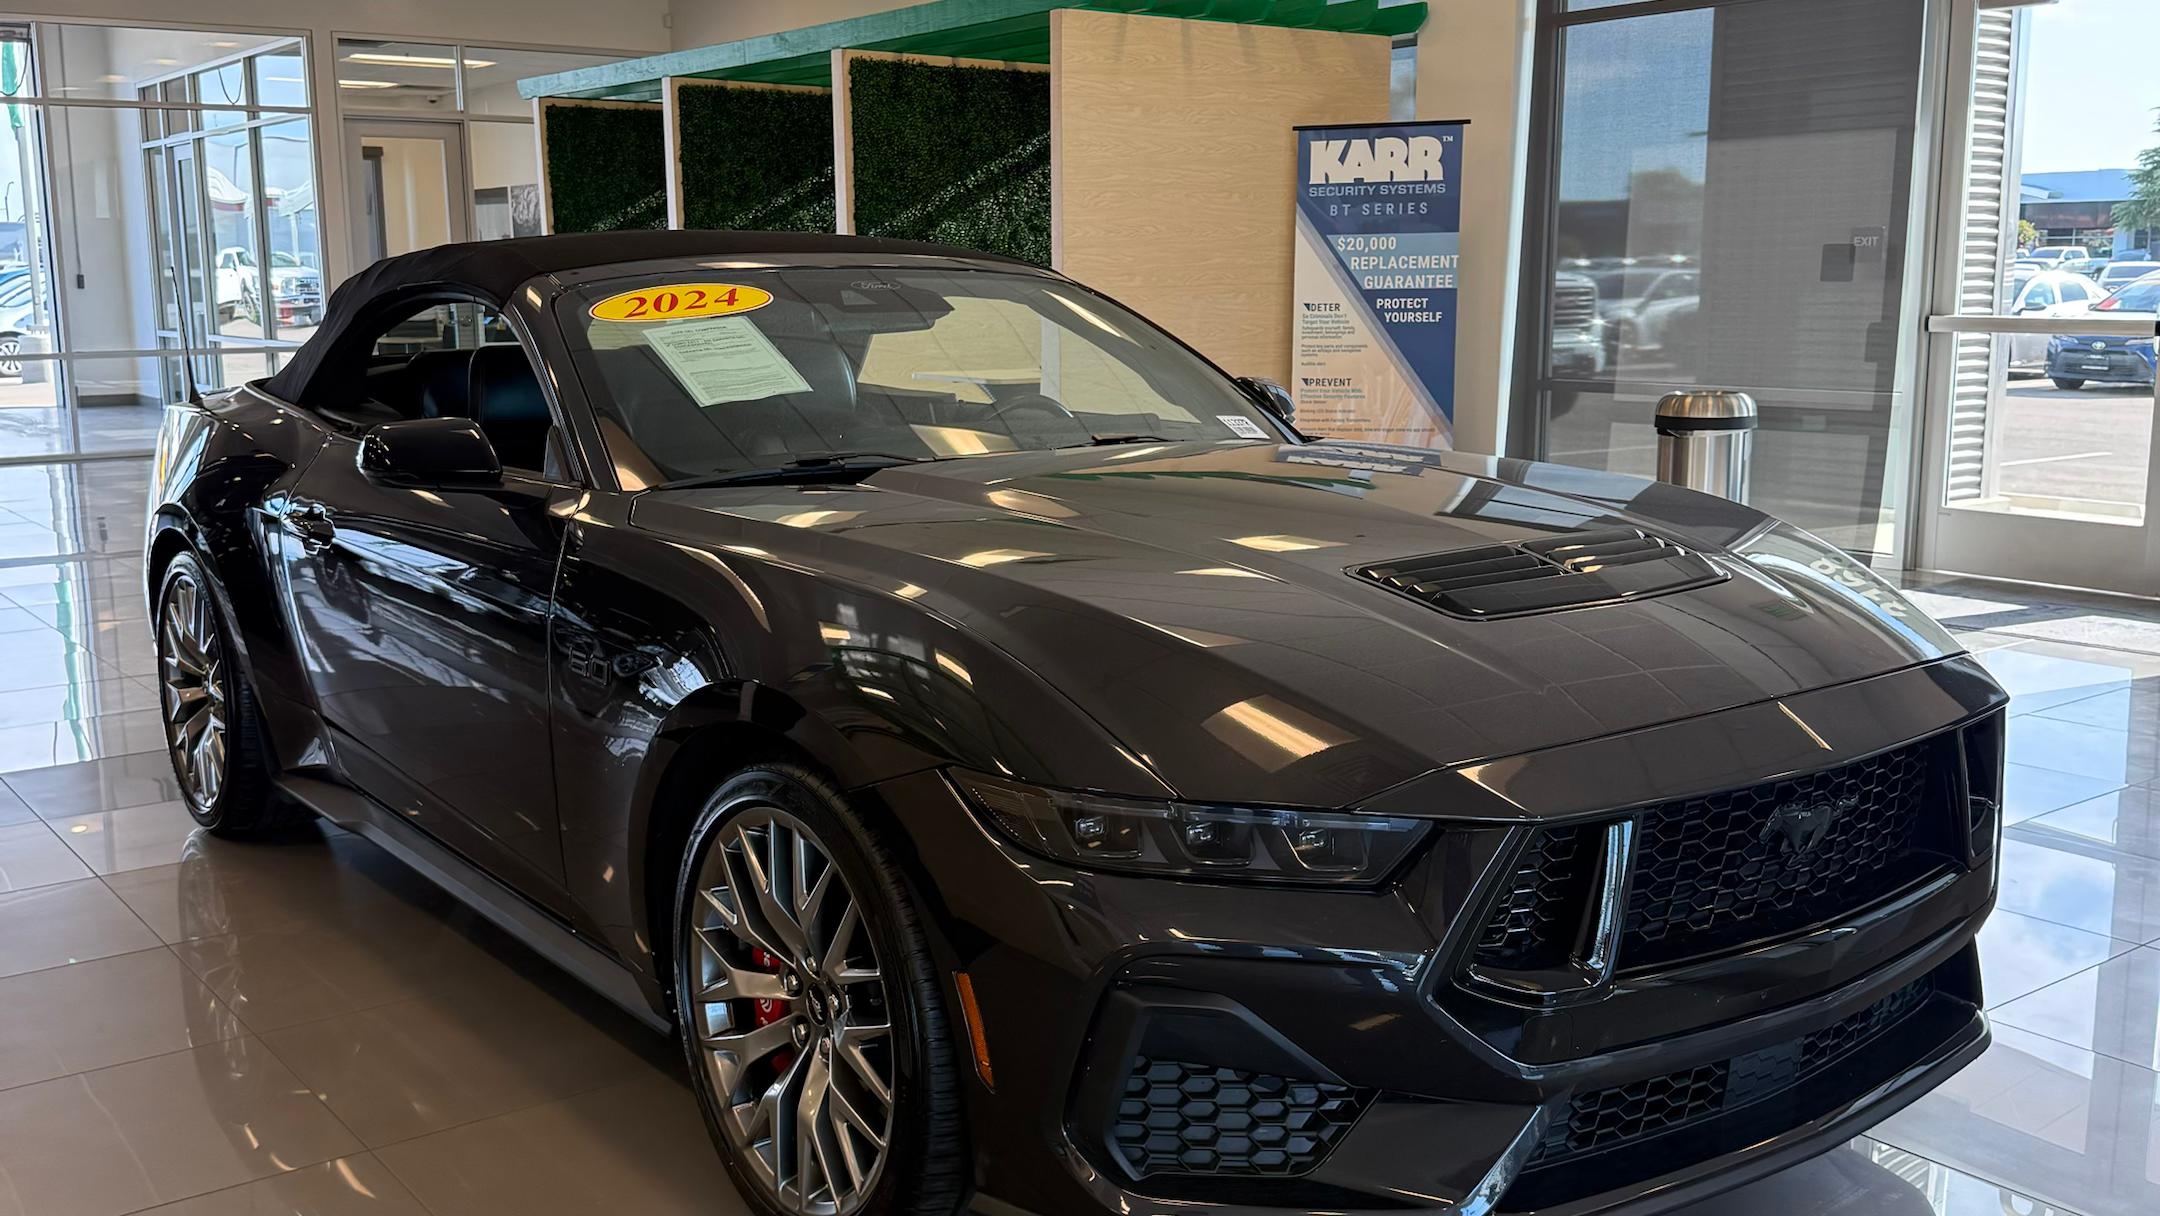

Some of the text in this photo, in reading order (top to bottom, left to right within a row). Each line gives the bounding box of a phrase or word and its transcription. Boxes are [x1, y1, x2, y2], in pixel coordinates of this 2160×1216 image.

[1309, 136, 1443, 184] KARR
[1309, 184, 1446, 198] SECURITY SYSTEMS
[1330, 202, 1428, 216] BT SERIES
[1337, 236, 1397, 253] $20,000
[1854, 236, 1879, 247] EXIT
[1351, 255, 1460, 270] REPLACEMENT
[1363, 275, 1454, 289] GUARANTEE
[624, 288, 739, 318] 2024
[1311, 303, 1341, 312] DETER
[1376, 298, 1428, 310] PROTECT
[1384, 312, 1442, 323] YOURSELF
[1309, 378, 1352, 387] PREVENT
